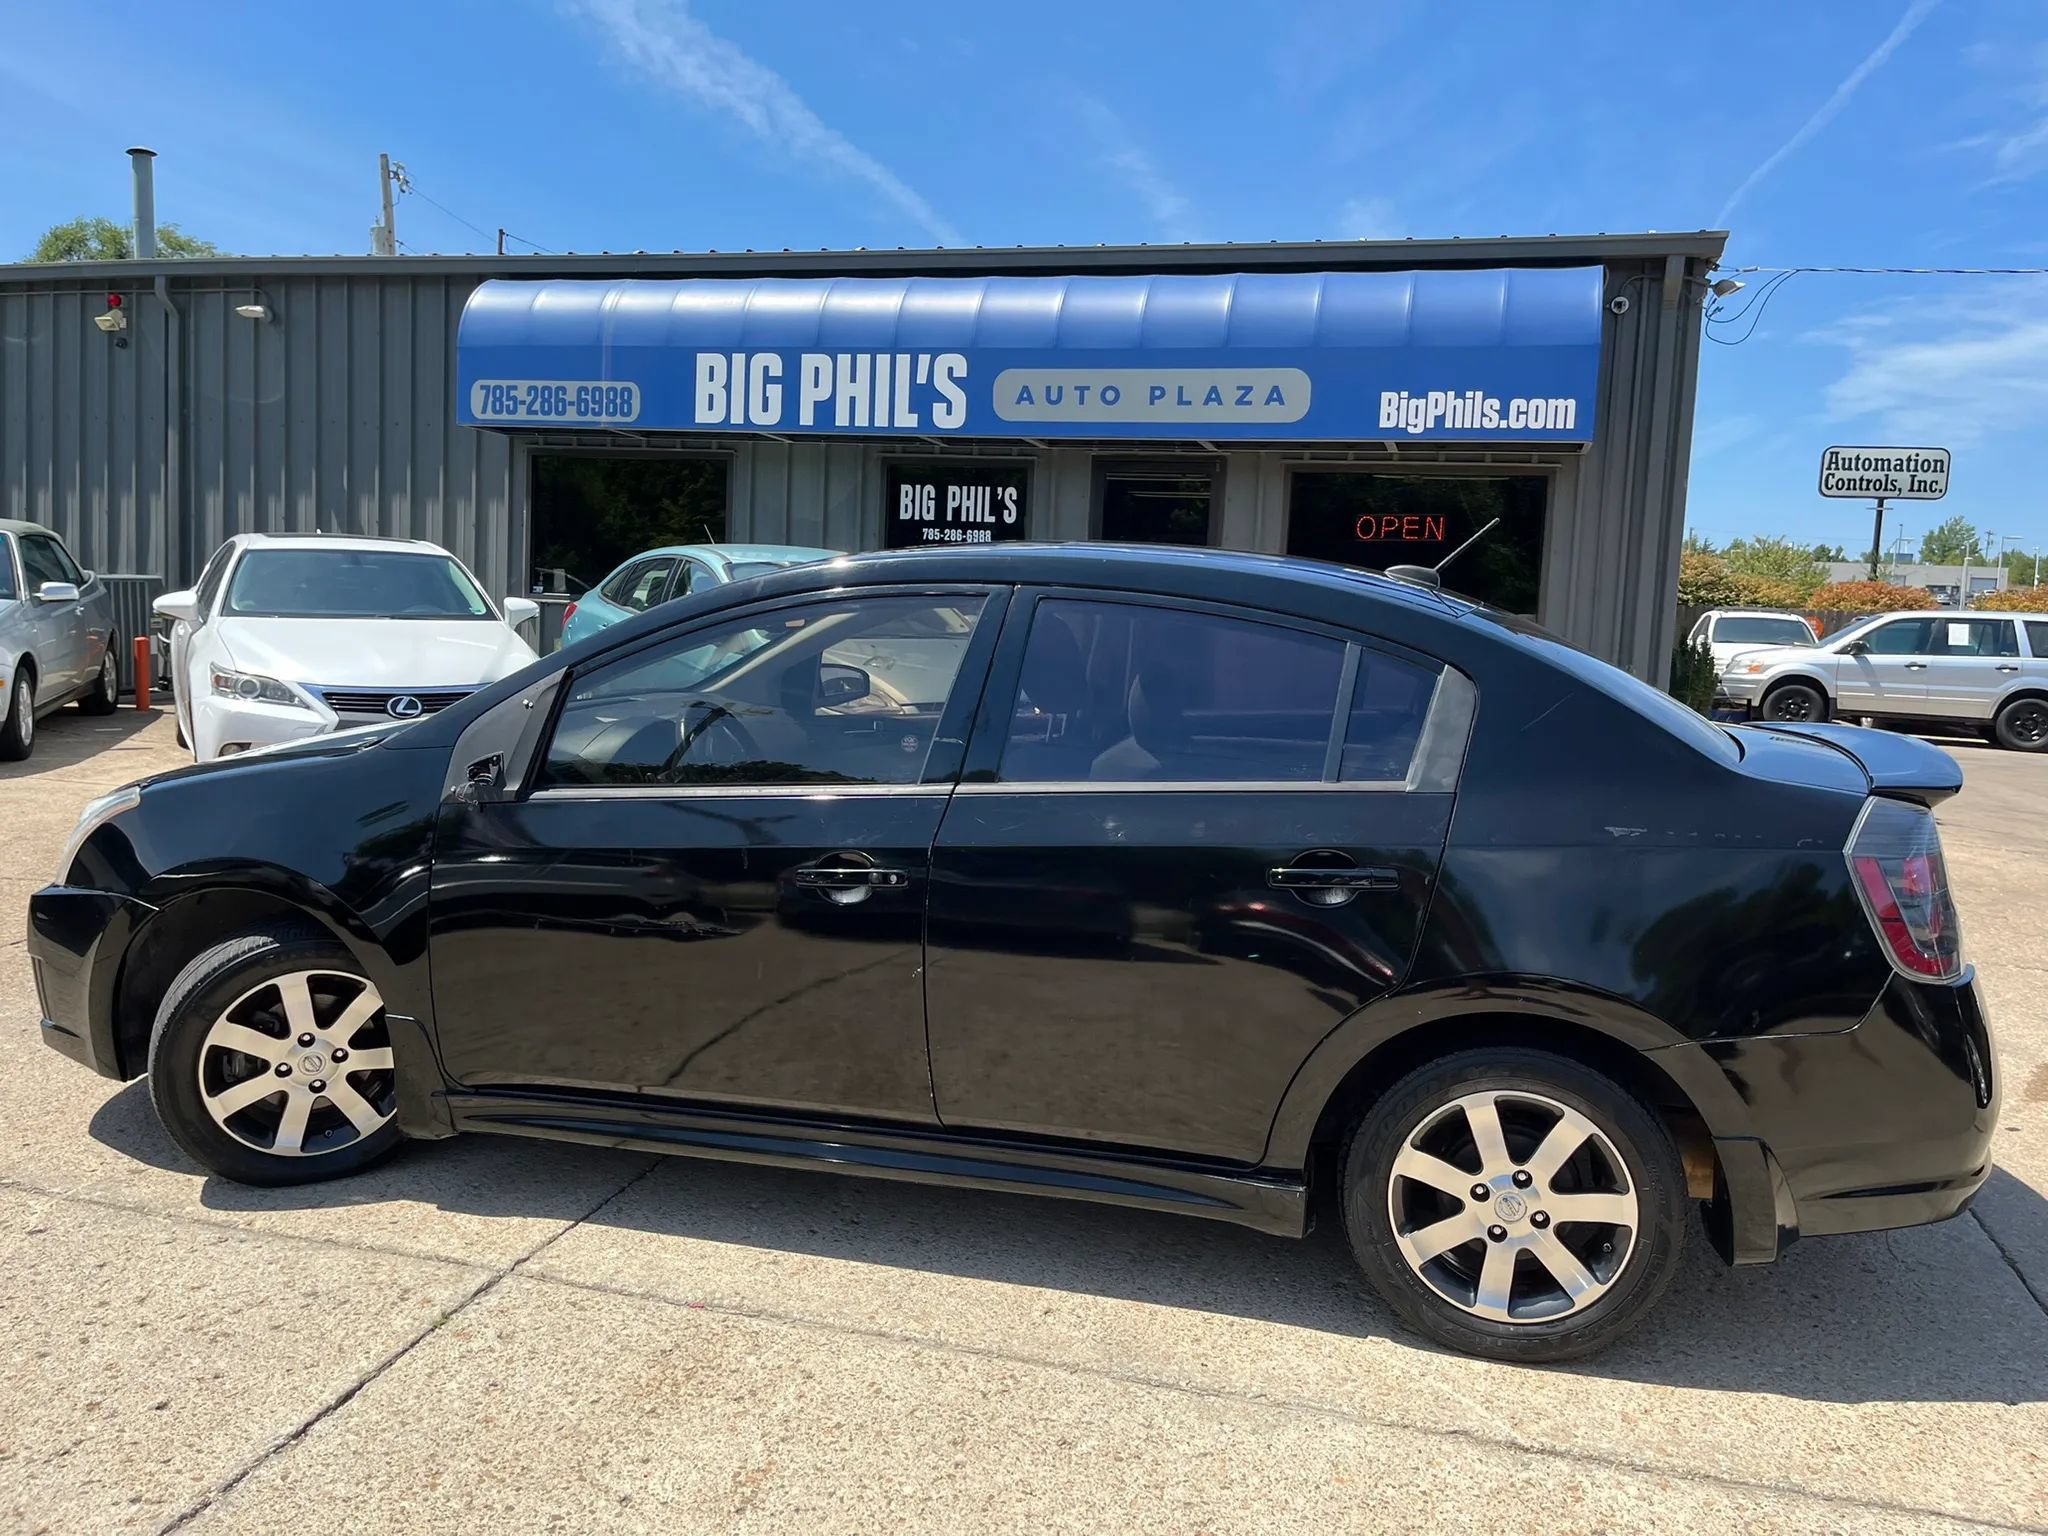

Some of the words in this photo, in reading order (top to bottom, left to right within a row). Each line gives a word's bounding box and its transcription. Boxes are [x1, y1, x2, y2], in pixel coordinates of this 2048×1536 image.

[479, 384, 633, 418] 785-286-6988
[695, 353, 783, 426] BIG
[799, 353, 968, 429] PHIL'S
[1015, 385, 1121, 406] AUTO
[1149, 385, 1286, 406] PLAZA
[1379, 391, 1576, 434] BigPhils.com
[1825, 451, 1945, 473] Automation
[1824, 472, 1902, 496] Controls,
[1908, 474, 1943, 493] Inc.
[900, 484, 936, 521] BIG
[946, 486, 1018, 524] PHIL'S
[922, 528, 992, 543] 785-286-6988
[1357, 516, 1444, 541] OPEN
